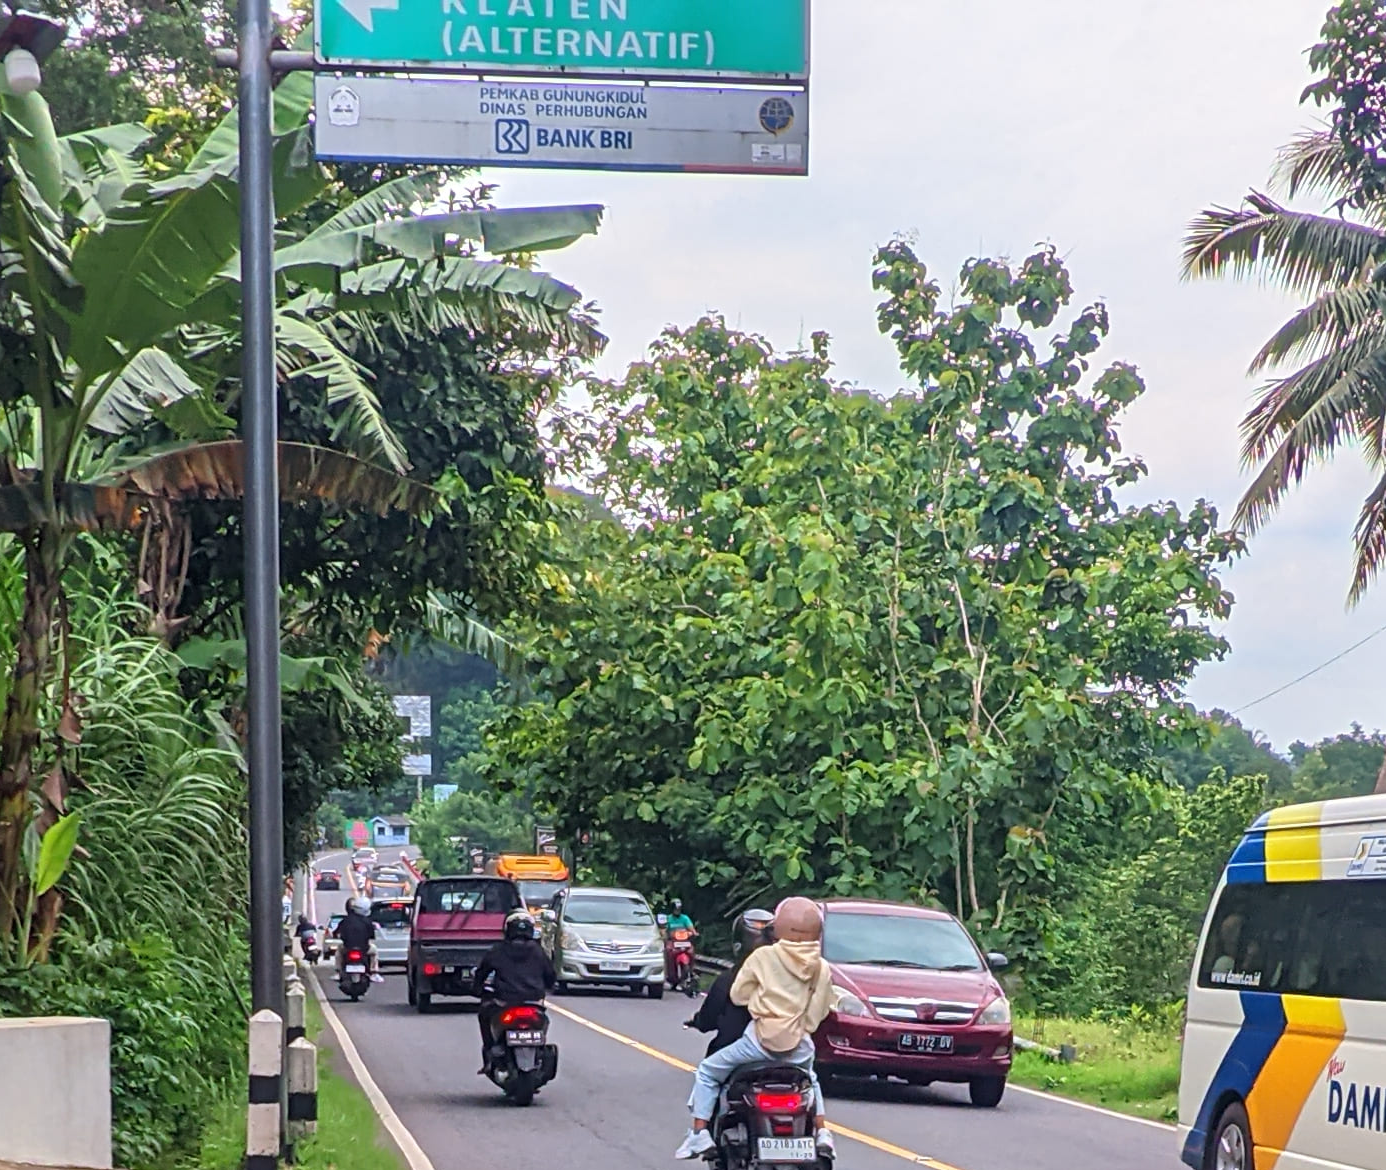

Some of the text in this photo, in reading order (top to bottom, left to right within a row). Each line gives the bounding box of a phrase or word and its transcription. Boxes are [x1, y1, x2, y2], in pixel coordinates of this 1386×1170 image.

[442, 20, 715, 65] (ALTERNATIF)
[480, 87, 647, 104] PEMKAB GUNUNGKIDUL
[480, 102, 647, 119] DINAS PERHUBUNGAN
[536, 127, 633, 150] BANK BRI
